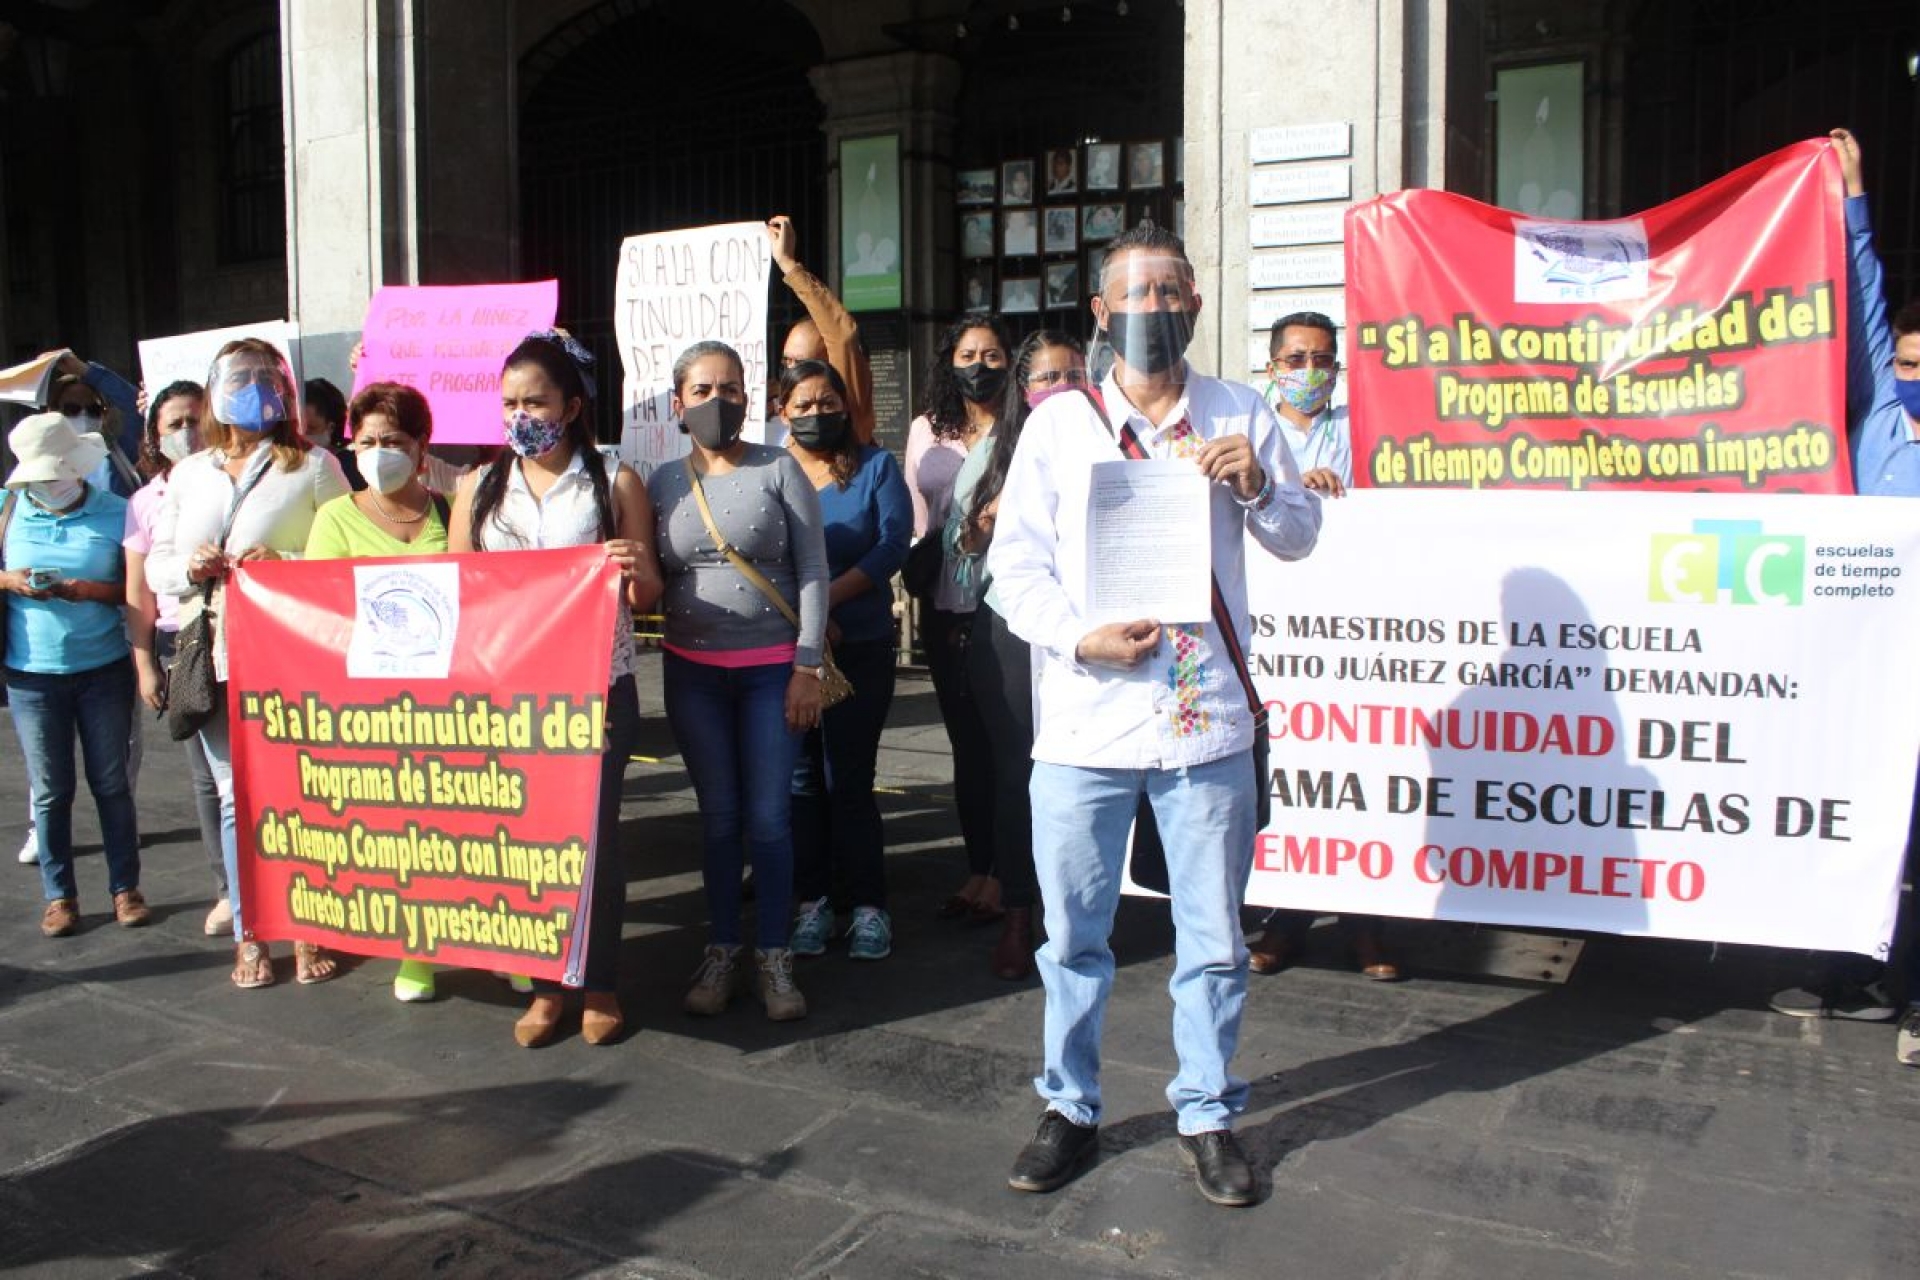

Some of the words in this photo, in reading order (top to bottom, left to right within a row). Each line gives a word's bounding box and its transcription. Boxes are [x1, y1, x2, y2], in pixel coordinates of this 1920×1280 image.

[626, 289, 752, 340] TINUIDAD
[1429, 330, 1449, 363] a
[1458, 319, 1492, 361] la
[1500, 300, 1748, 364] continuidad
[1759, 287, 1831, 343] del
[1439, 375, 1569, 427] Programa
[1575, 374, 1609, 414] de
[1615, 363, 1739, 414] Escuelas
[1375, 441, 1407, 484] de
[1408, 437, 1505, 489] Tiempo
[1510, 435, 1642, 489] Completo
[1647, 442, 1700, 476] con
[1704, 427, 1830, 484] impacto
[1814, 563, 1837, 577] de
[1842, 563, 1902, 580] tiempo
[1815, 544, 1895, 558] escuelas
[1813, 583, 1895, 600] completo
[1287, 615, 1446, 644] MAESTROS
[1457, 620, 1499, 646] DE
[1510, 621, 1547, 648] LA
[1559, 623, 1703, 653] ESCUELA
[1334, 652, 1447, 684] JUÁREZ
[1604, 667, 1798, 700] DEMANDAN:
[288, 708, 303, 740] a
[306, 698, 333, 742] la
[340, 698, 531, 748] continuidad
[541, 700, 603, 749] del
[1263, 700, 1615, 757] CONTINUIDAD
[1637, 718, 1747, 764] DEL
[300, 754, 395, 811] Programa
[399, 757, 426, 804] de
[428, 761, 523, 809] Escuelas
[1387, 774, 1455, 818] DE
[1474, 780, 1751, 835] ESCUELAS
[1774, 795, 1852, 842] DE
[262, 812, 289, 855] de
[288, 815, 348, 875] Tiempo
[351, 824, 457, 883] Completo
[460, 840, 498, 876] con
[500, 831, 587, 896] impact
[1254, 833, 1394, 880] EMPO
[1413, 844, 1706, 902] COMPLETO
[291, 876, 345, 930] directo
[348, 889, 367, 932] al
[370, 892, 397, 935] 07
[402, 904, 418, 948] y
[422, 899, 567, 955] prestaciones"
